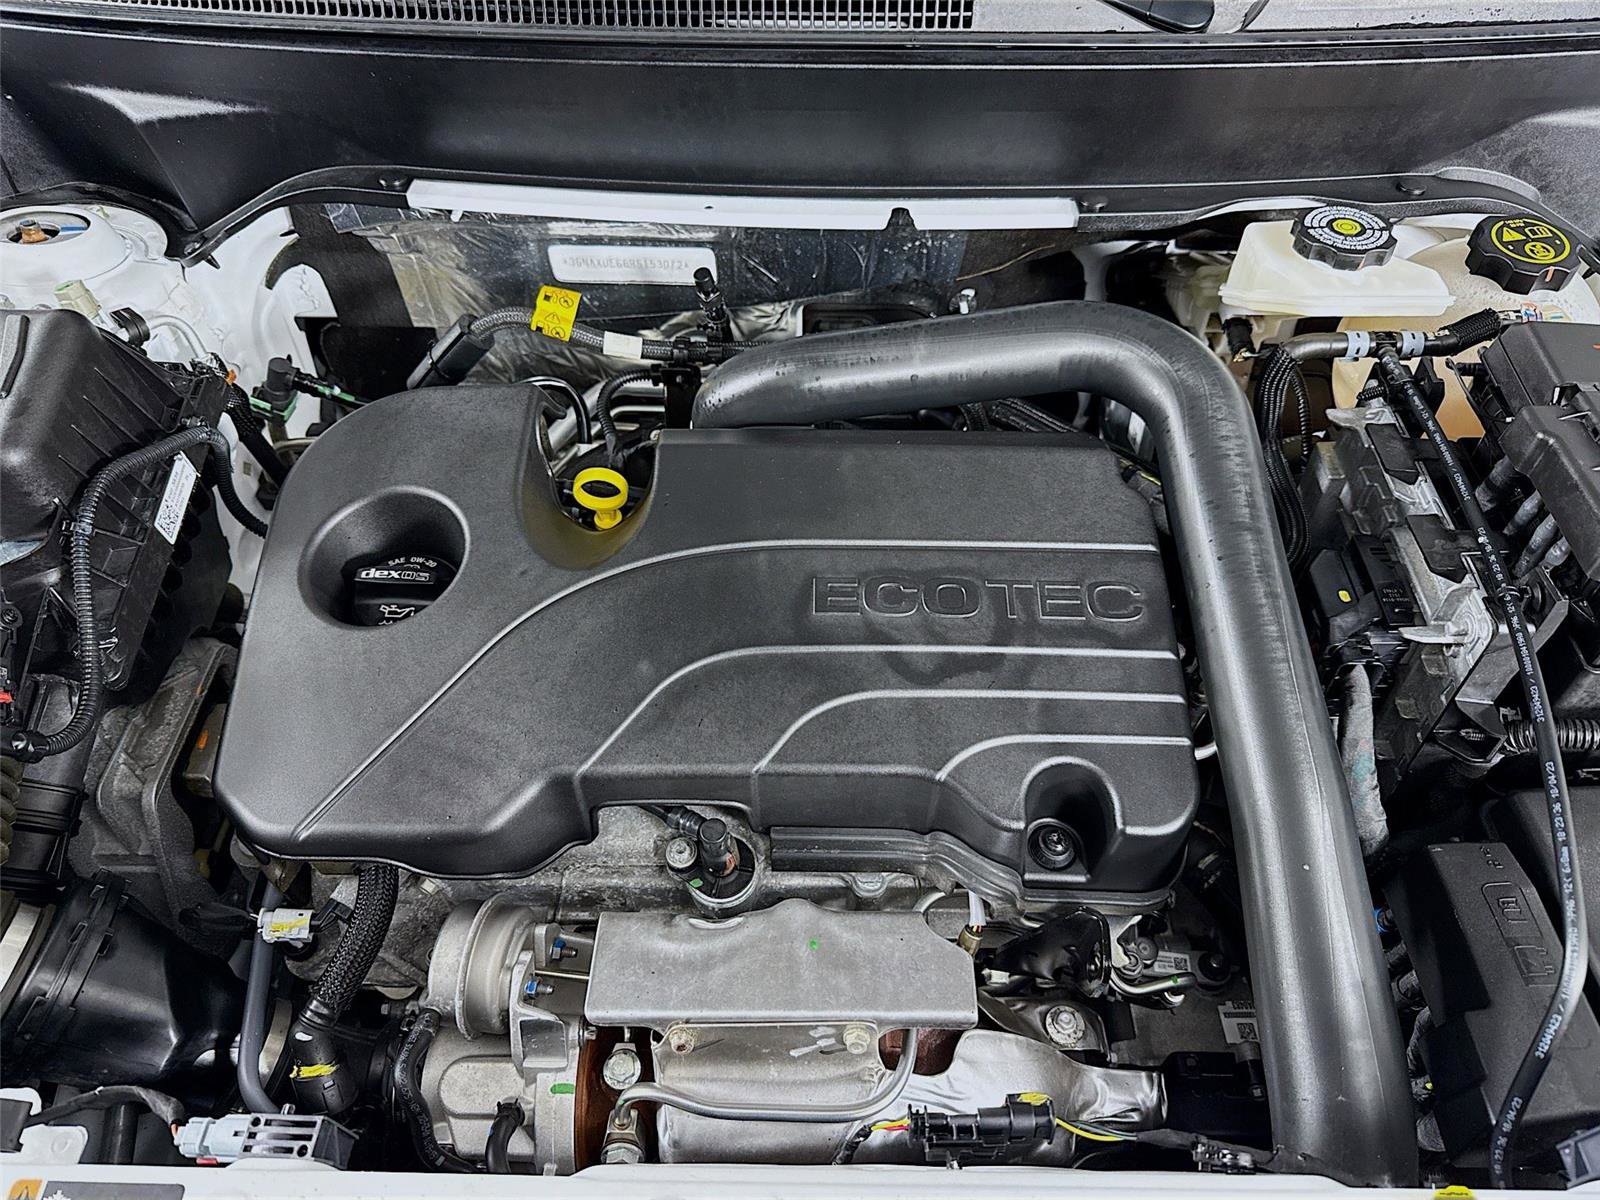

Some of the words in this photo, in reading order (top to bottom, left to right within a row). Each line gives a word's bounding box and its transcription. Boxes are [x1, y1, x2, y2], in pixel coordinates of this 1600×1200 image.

[388, 557, 406, 567] SAE
[410, 556, 438, 568] 0W-20
[812, 576, 1145, 623] ECOTEC
[1545, 761, 1559, 798] 18/04/23
